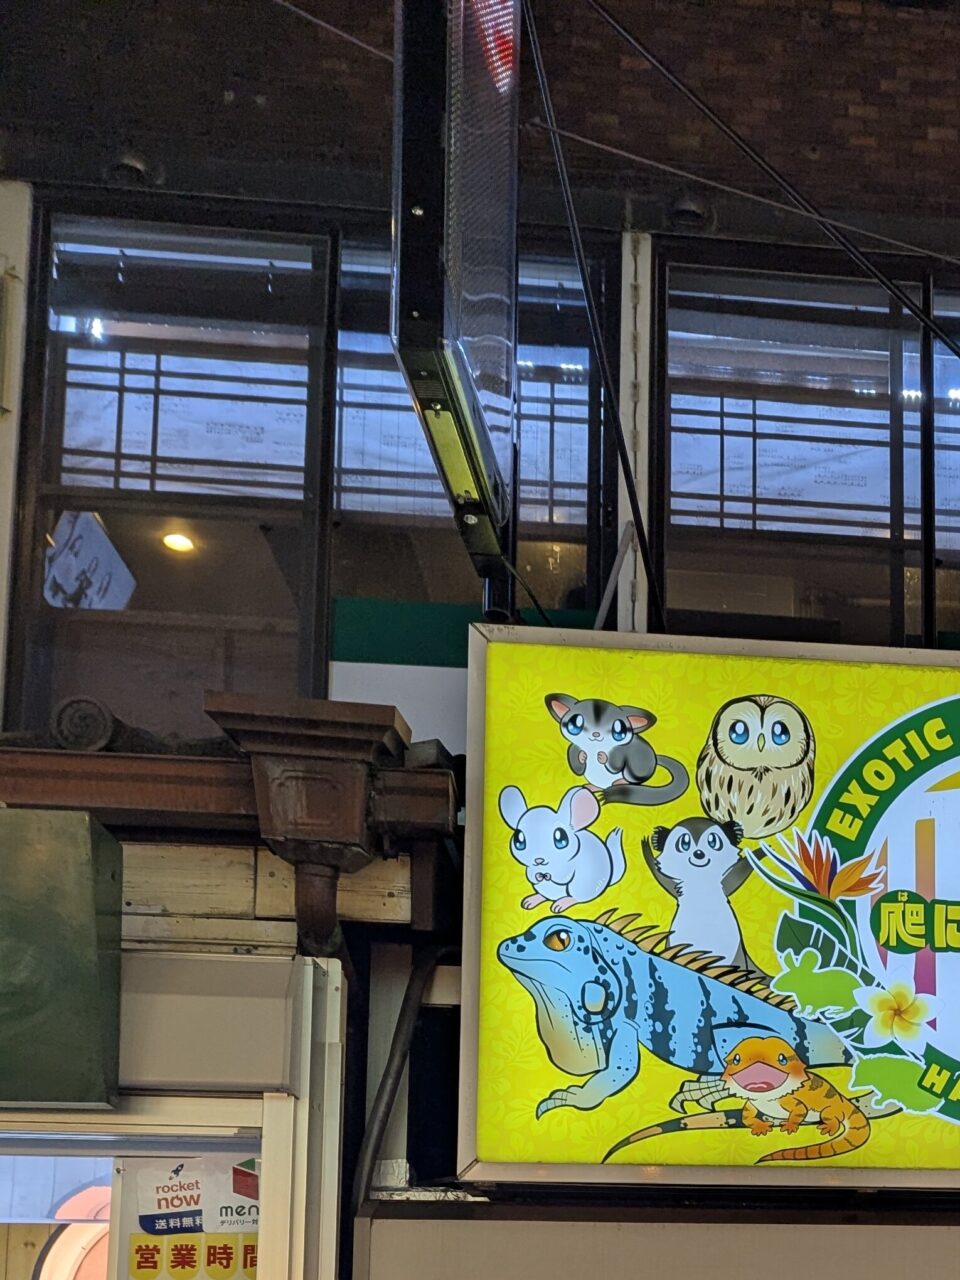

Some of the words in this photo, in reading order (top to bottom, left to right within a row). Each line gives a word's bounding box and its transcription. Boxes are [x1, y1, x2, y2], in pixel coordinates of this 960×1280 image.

[825, 718, 953, 842] EXOTIC
[156, 1180, 200, 1193] rocket
[157, 1194, 201, 1210] now
